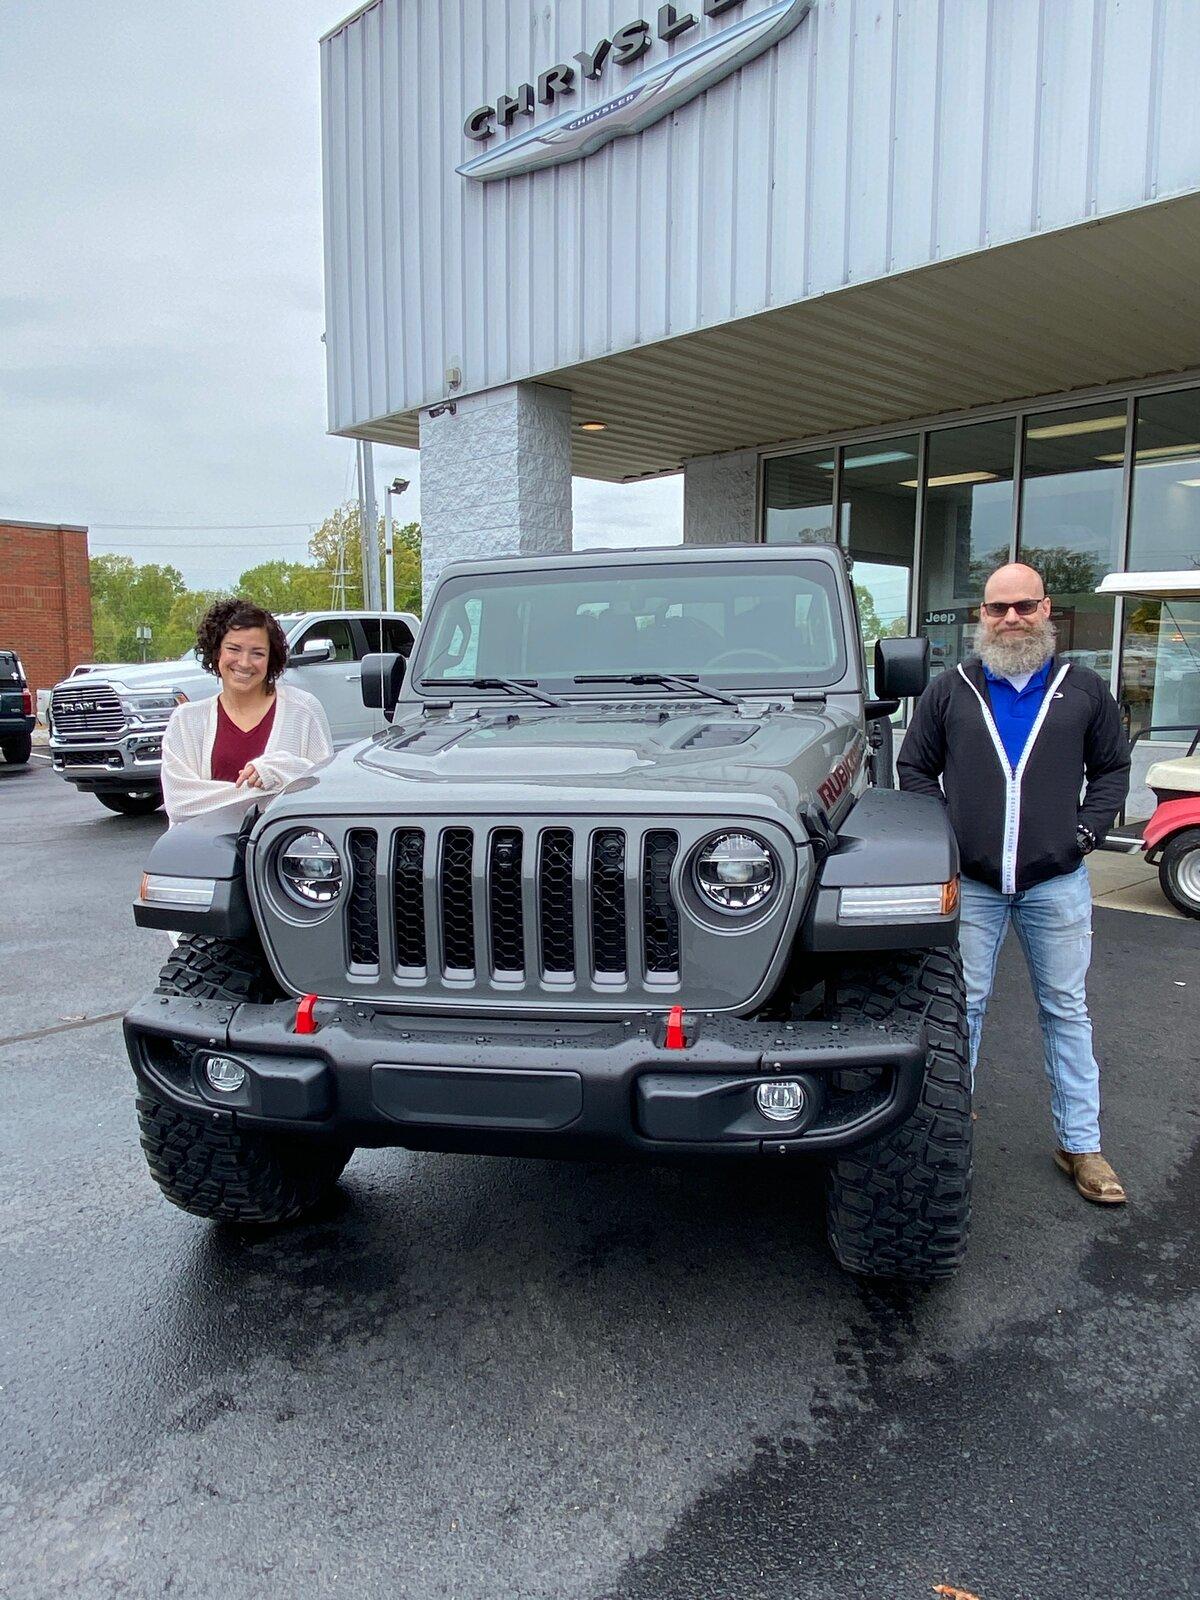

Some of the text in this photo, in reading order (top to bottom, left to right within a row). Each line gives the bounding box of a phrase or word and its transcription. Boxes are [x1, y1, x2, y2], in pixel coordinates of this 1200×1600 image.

[569, 94, 634, 130] CHRYSLER
[925, 612, 956, 625] Jeep
[61, 701, 95, 714] RAM
